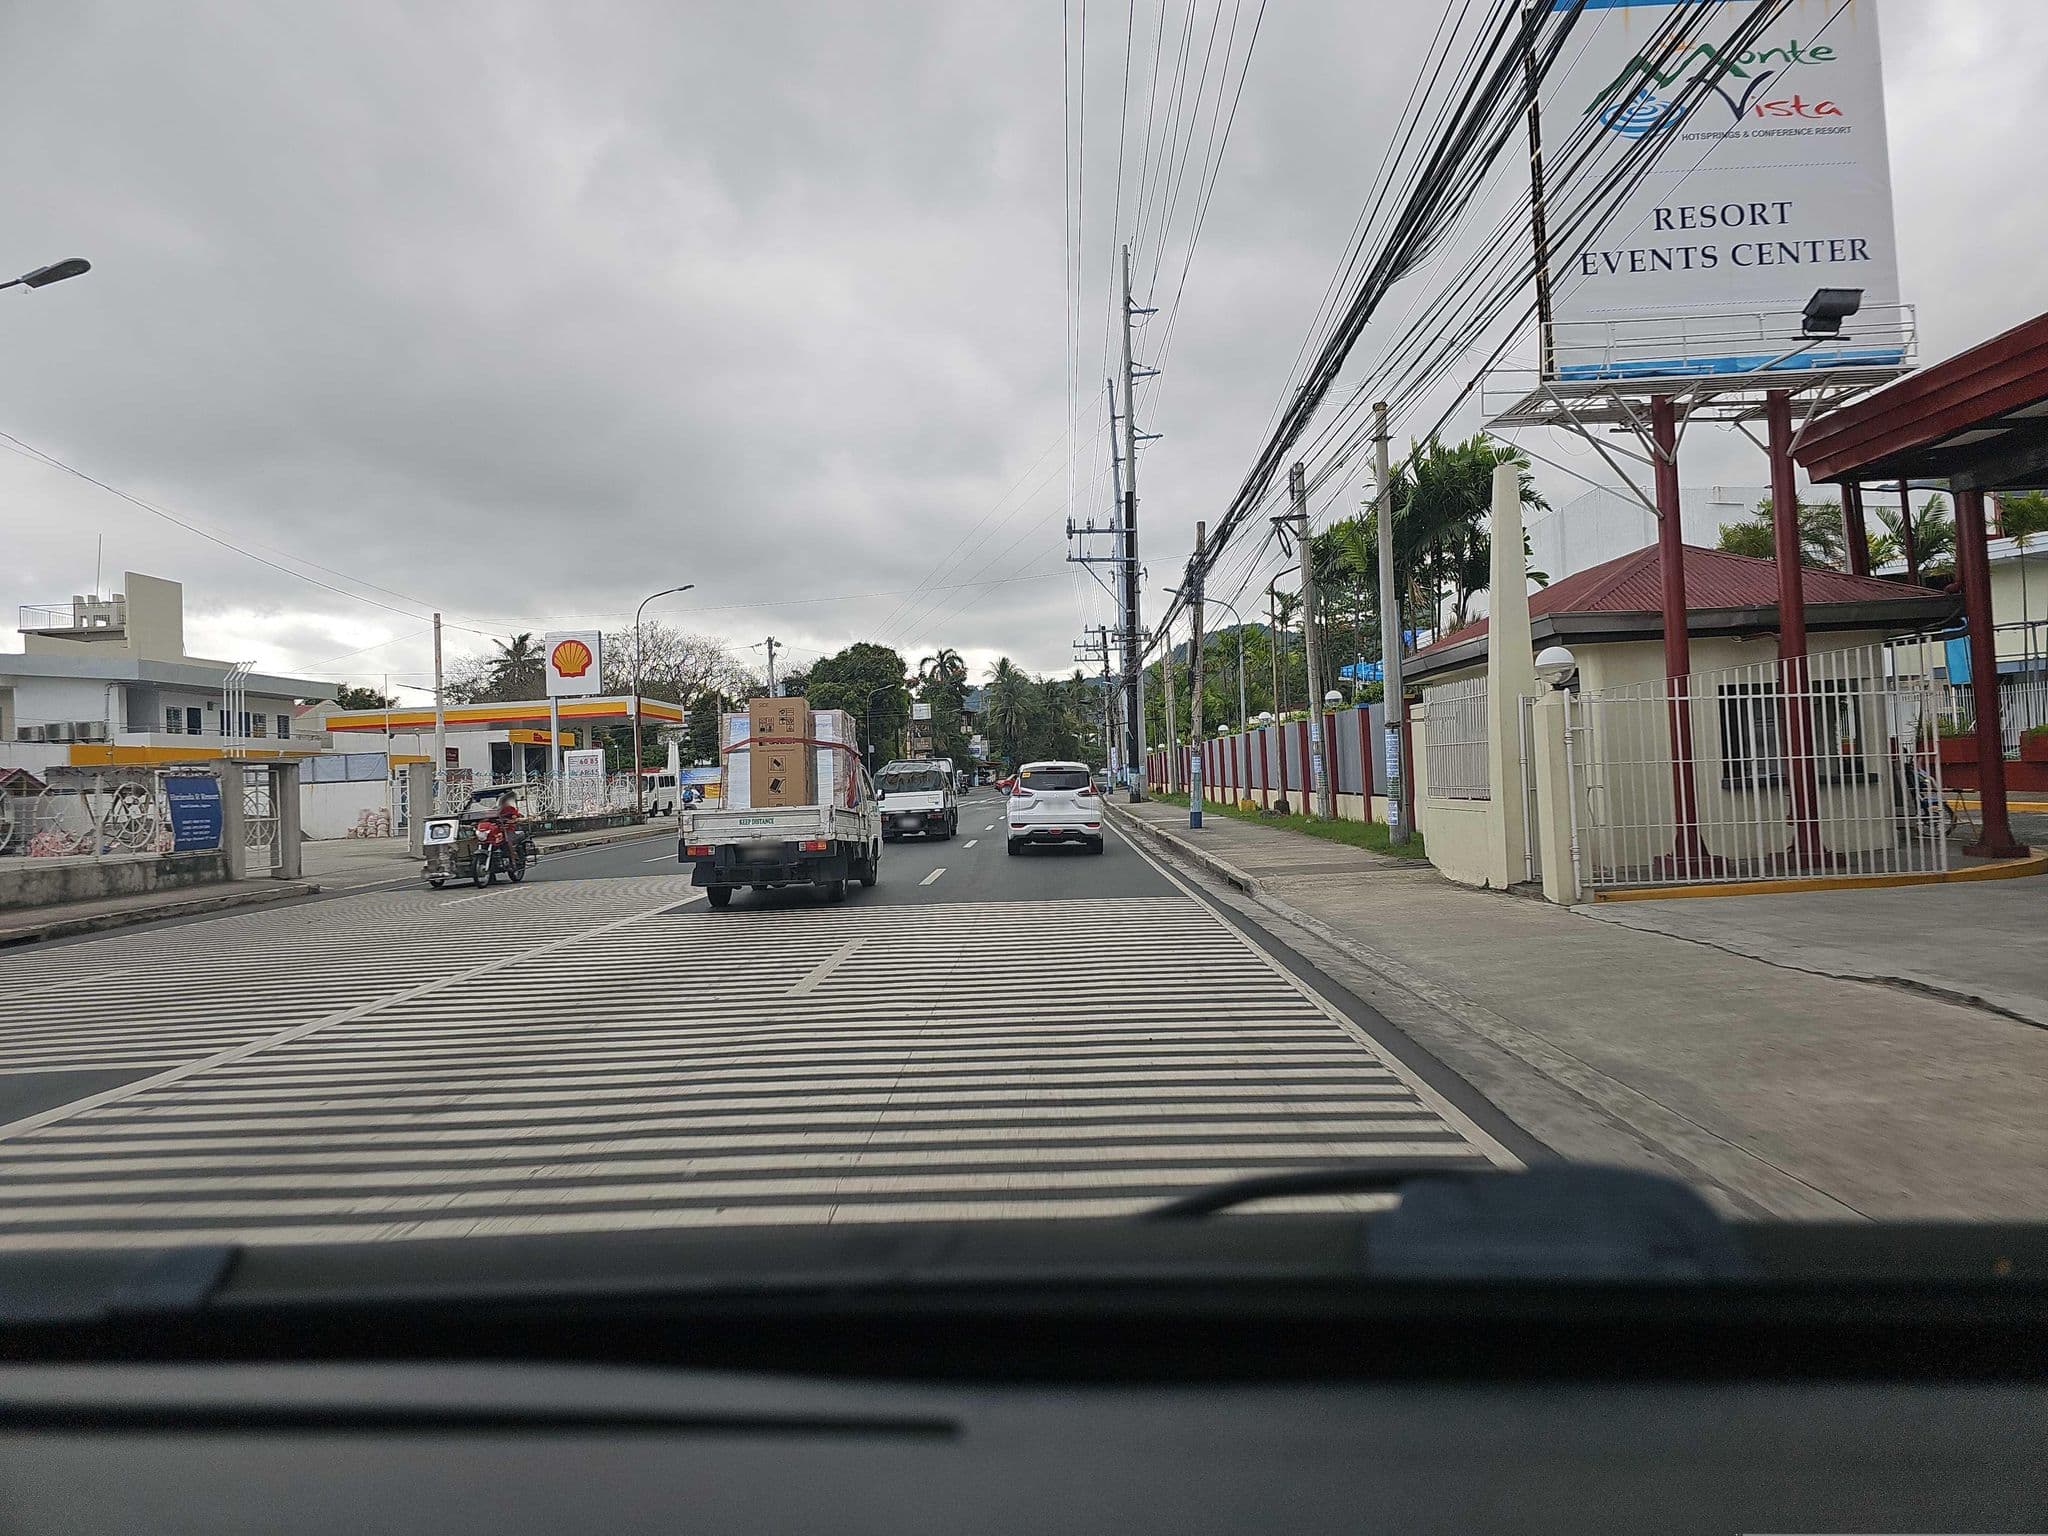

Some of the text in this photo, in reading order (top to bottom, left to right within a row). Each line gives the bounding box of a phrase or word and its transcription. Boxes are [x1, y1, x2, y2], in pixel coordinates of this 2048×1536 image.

[1582, 40, 1837, 116] Monte
[1687, 70, 1843, 121] Vista
[1681, 131, 1741, 141] HOTSPRINGS
[1751, 128, 1814, 138] CONFERENCE
[1814, 126, 1852, 135] RESORT
[1654, 201, 1793, 230] RESORT
[1580, 238, 1872, 276] EVENTS CENTER
